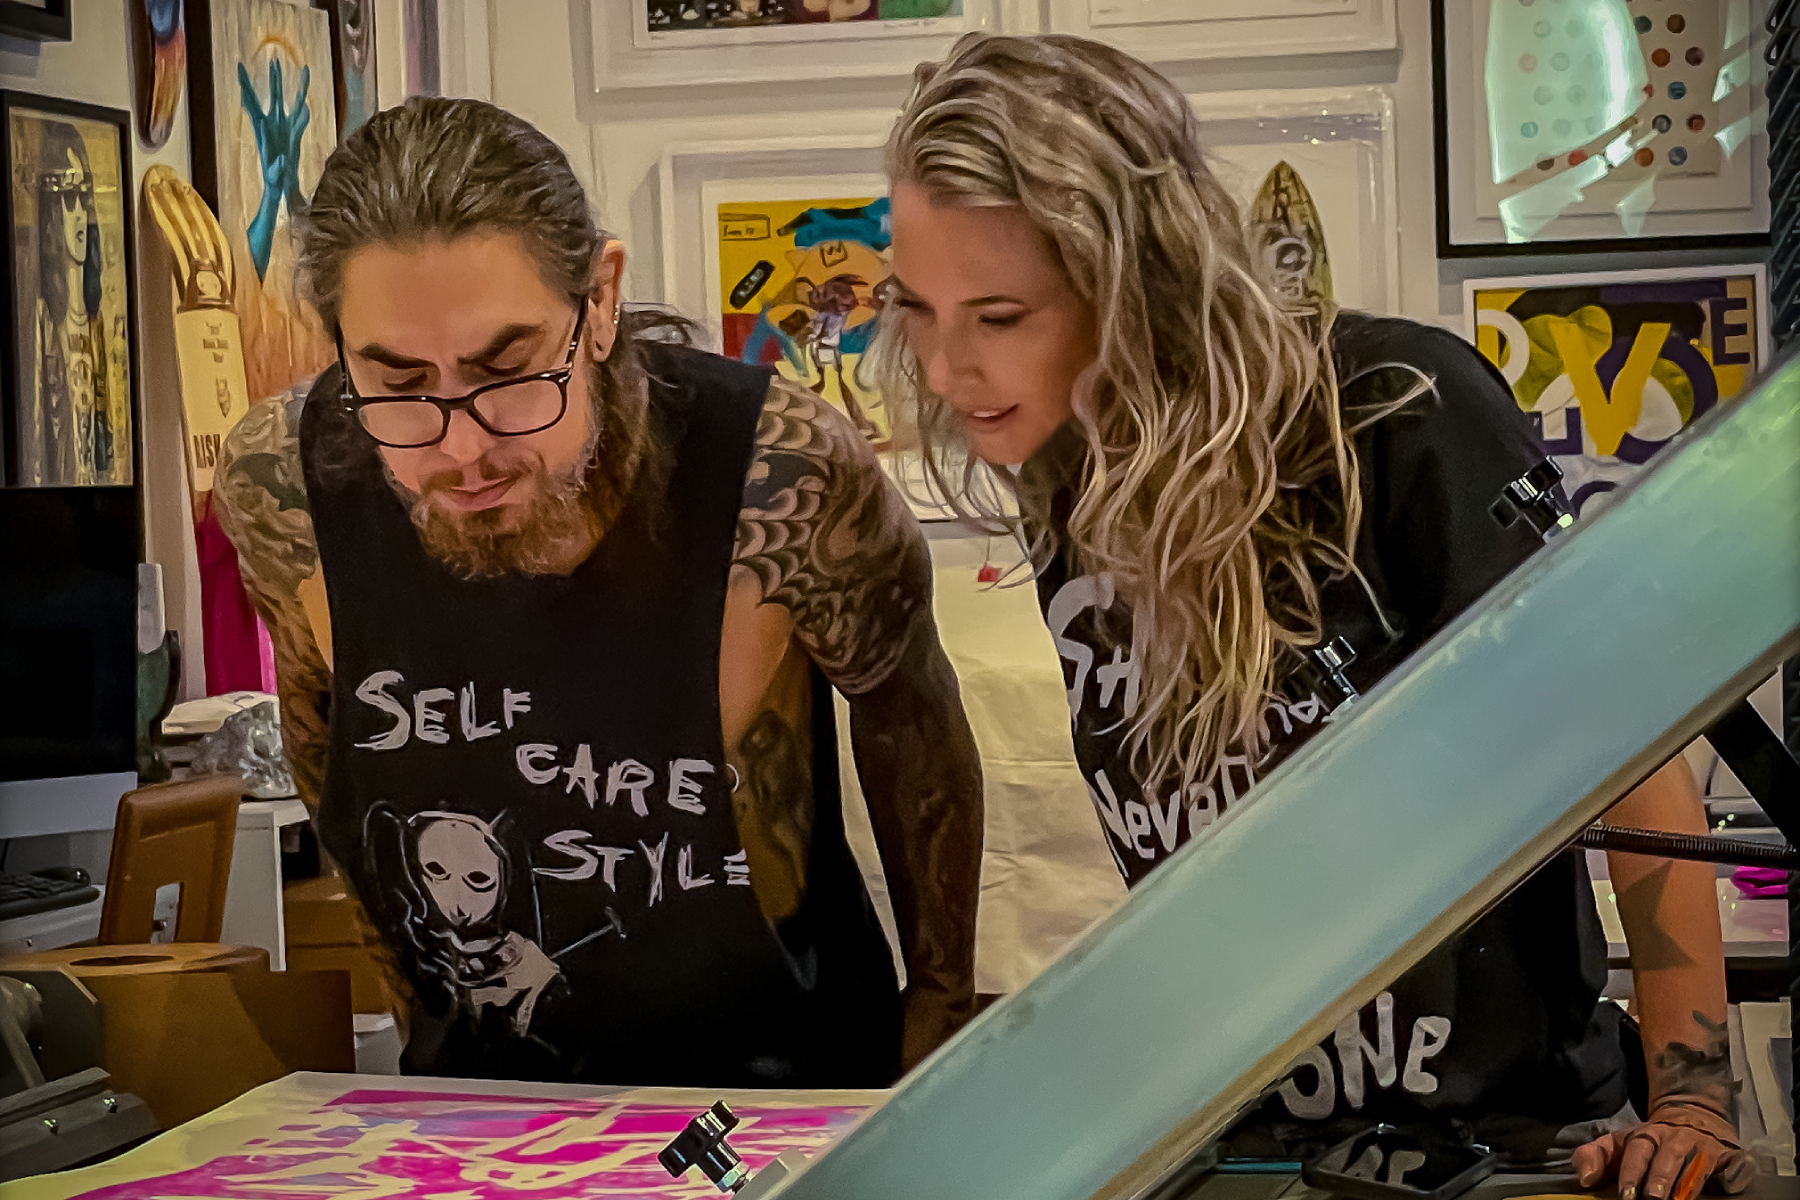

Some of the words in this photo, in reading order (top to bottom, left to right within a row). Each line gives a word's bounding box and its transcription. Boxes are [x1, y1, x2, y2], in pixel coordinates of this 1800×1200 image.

[355, 669, 532, 751] SELF
[515, 742, 715, 817] CARE
[532, 829, 751, 908] STYLE
